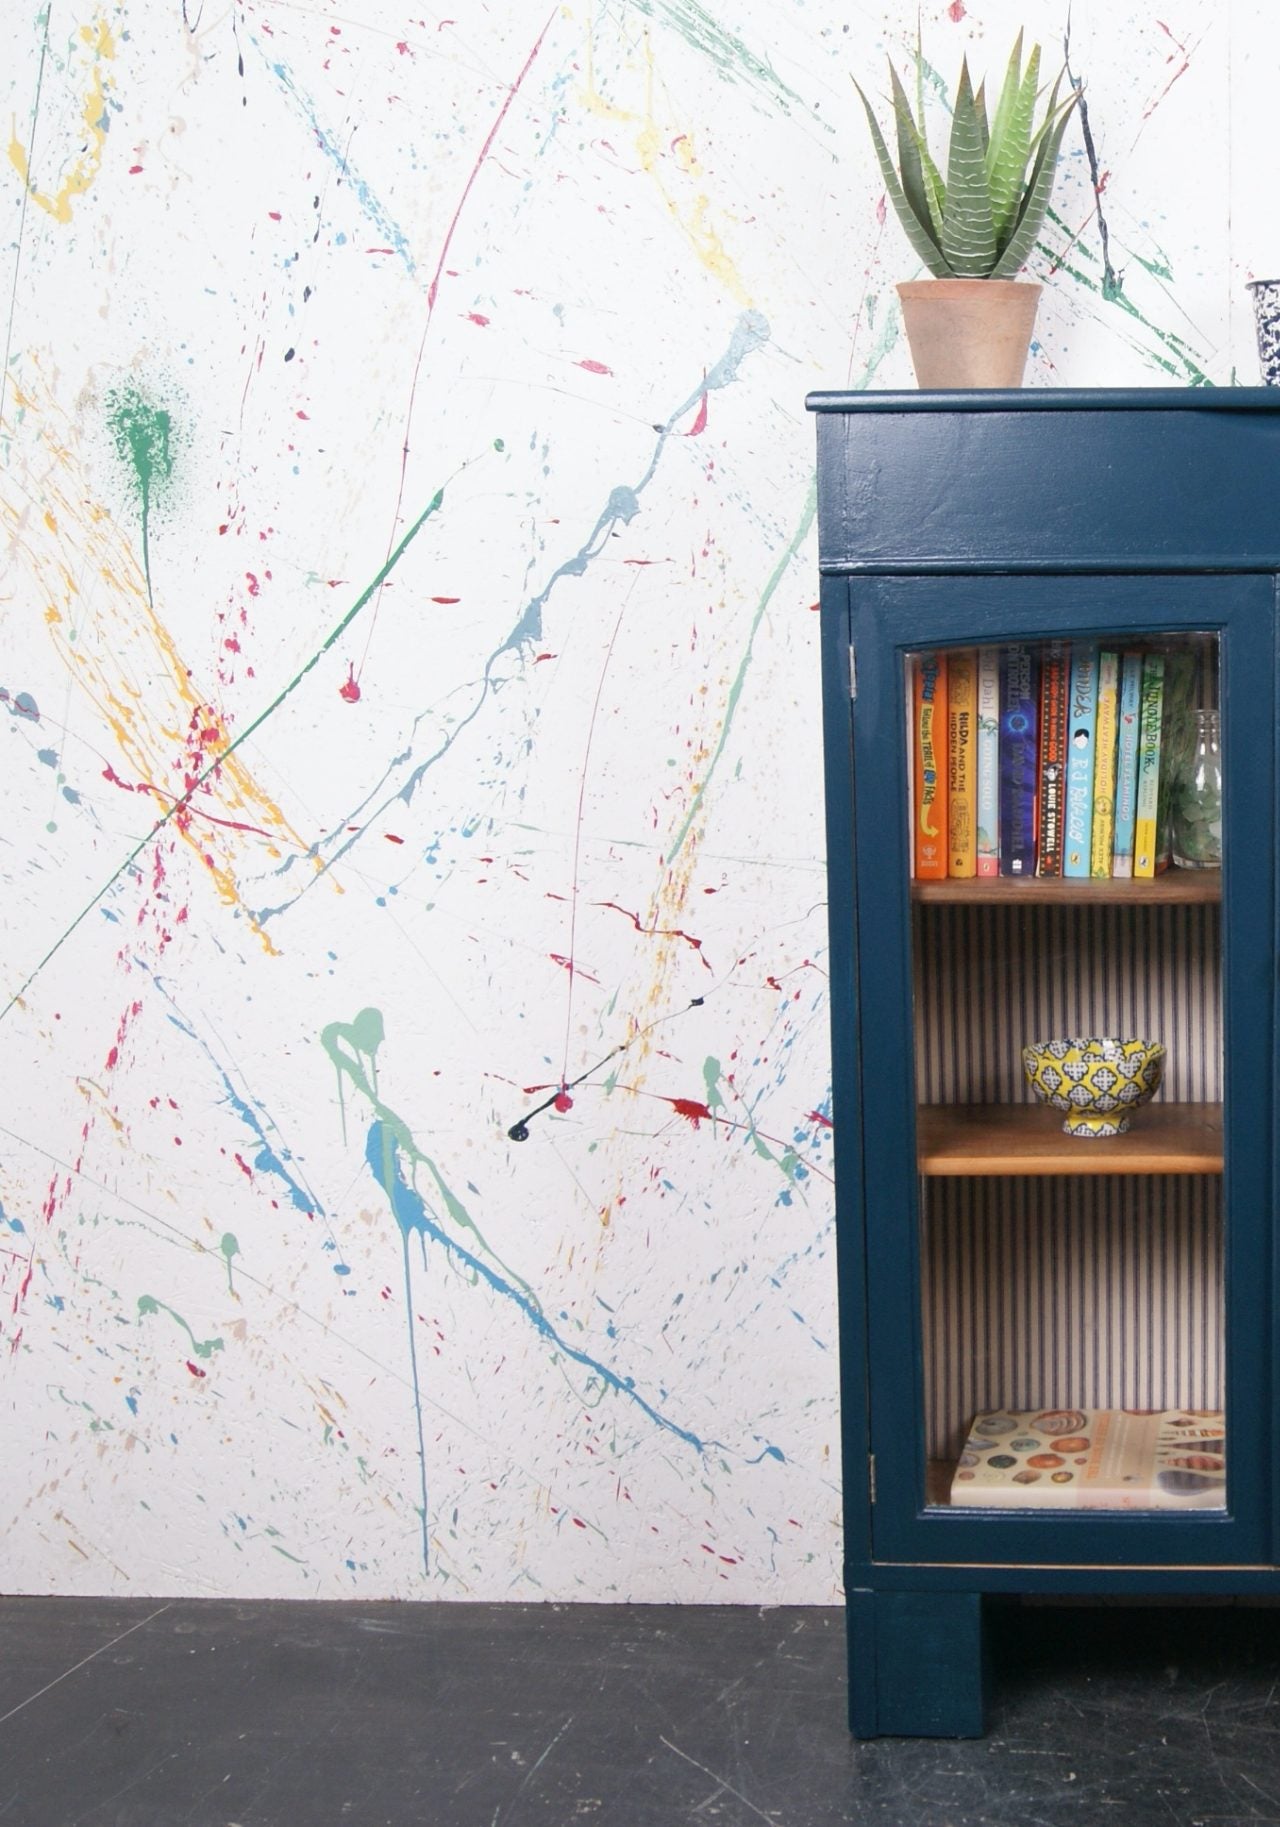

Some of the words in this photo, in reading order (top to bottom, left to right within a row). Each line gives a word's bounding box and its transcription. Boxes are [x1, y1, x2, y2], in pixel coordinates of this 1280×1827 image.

[1006, 643, 1021, 713] ONTROLLER
[1019, 654, 1031, 700] PERSON
[1074, 656, 1093, 719] ONDER
[982, 679, 995, 710] Dahl
[950, 712, 958, 753] HIDDEN
[958, 712, 970, 746] HILDA
[1102, 697, 1110, 750] HEATWAVE
[922, 741, 934, 762] TRAIL
[924, 761, 935, 769] of
[958, 747, 967, 771] AND
[1048, 741, 1058, 763] GOOD
[1071, 758, 1090, 769] R
[1143, 733, 1158, 774] BOOK
[950, 757, 958, 793] PEOPLE
[958, 774, 967, 793] THE
[1071, 771, 1089, 781] J
[1100, 751, 1108, 793] HOLIDAY
[982, 781, 994, 810] SOLO
[1047, 783, 1057, 809] LOUIE
[1121, 768, 1132, 822] FLAMINGO
[1046, 811, 1056, 853] STOWELL
